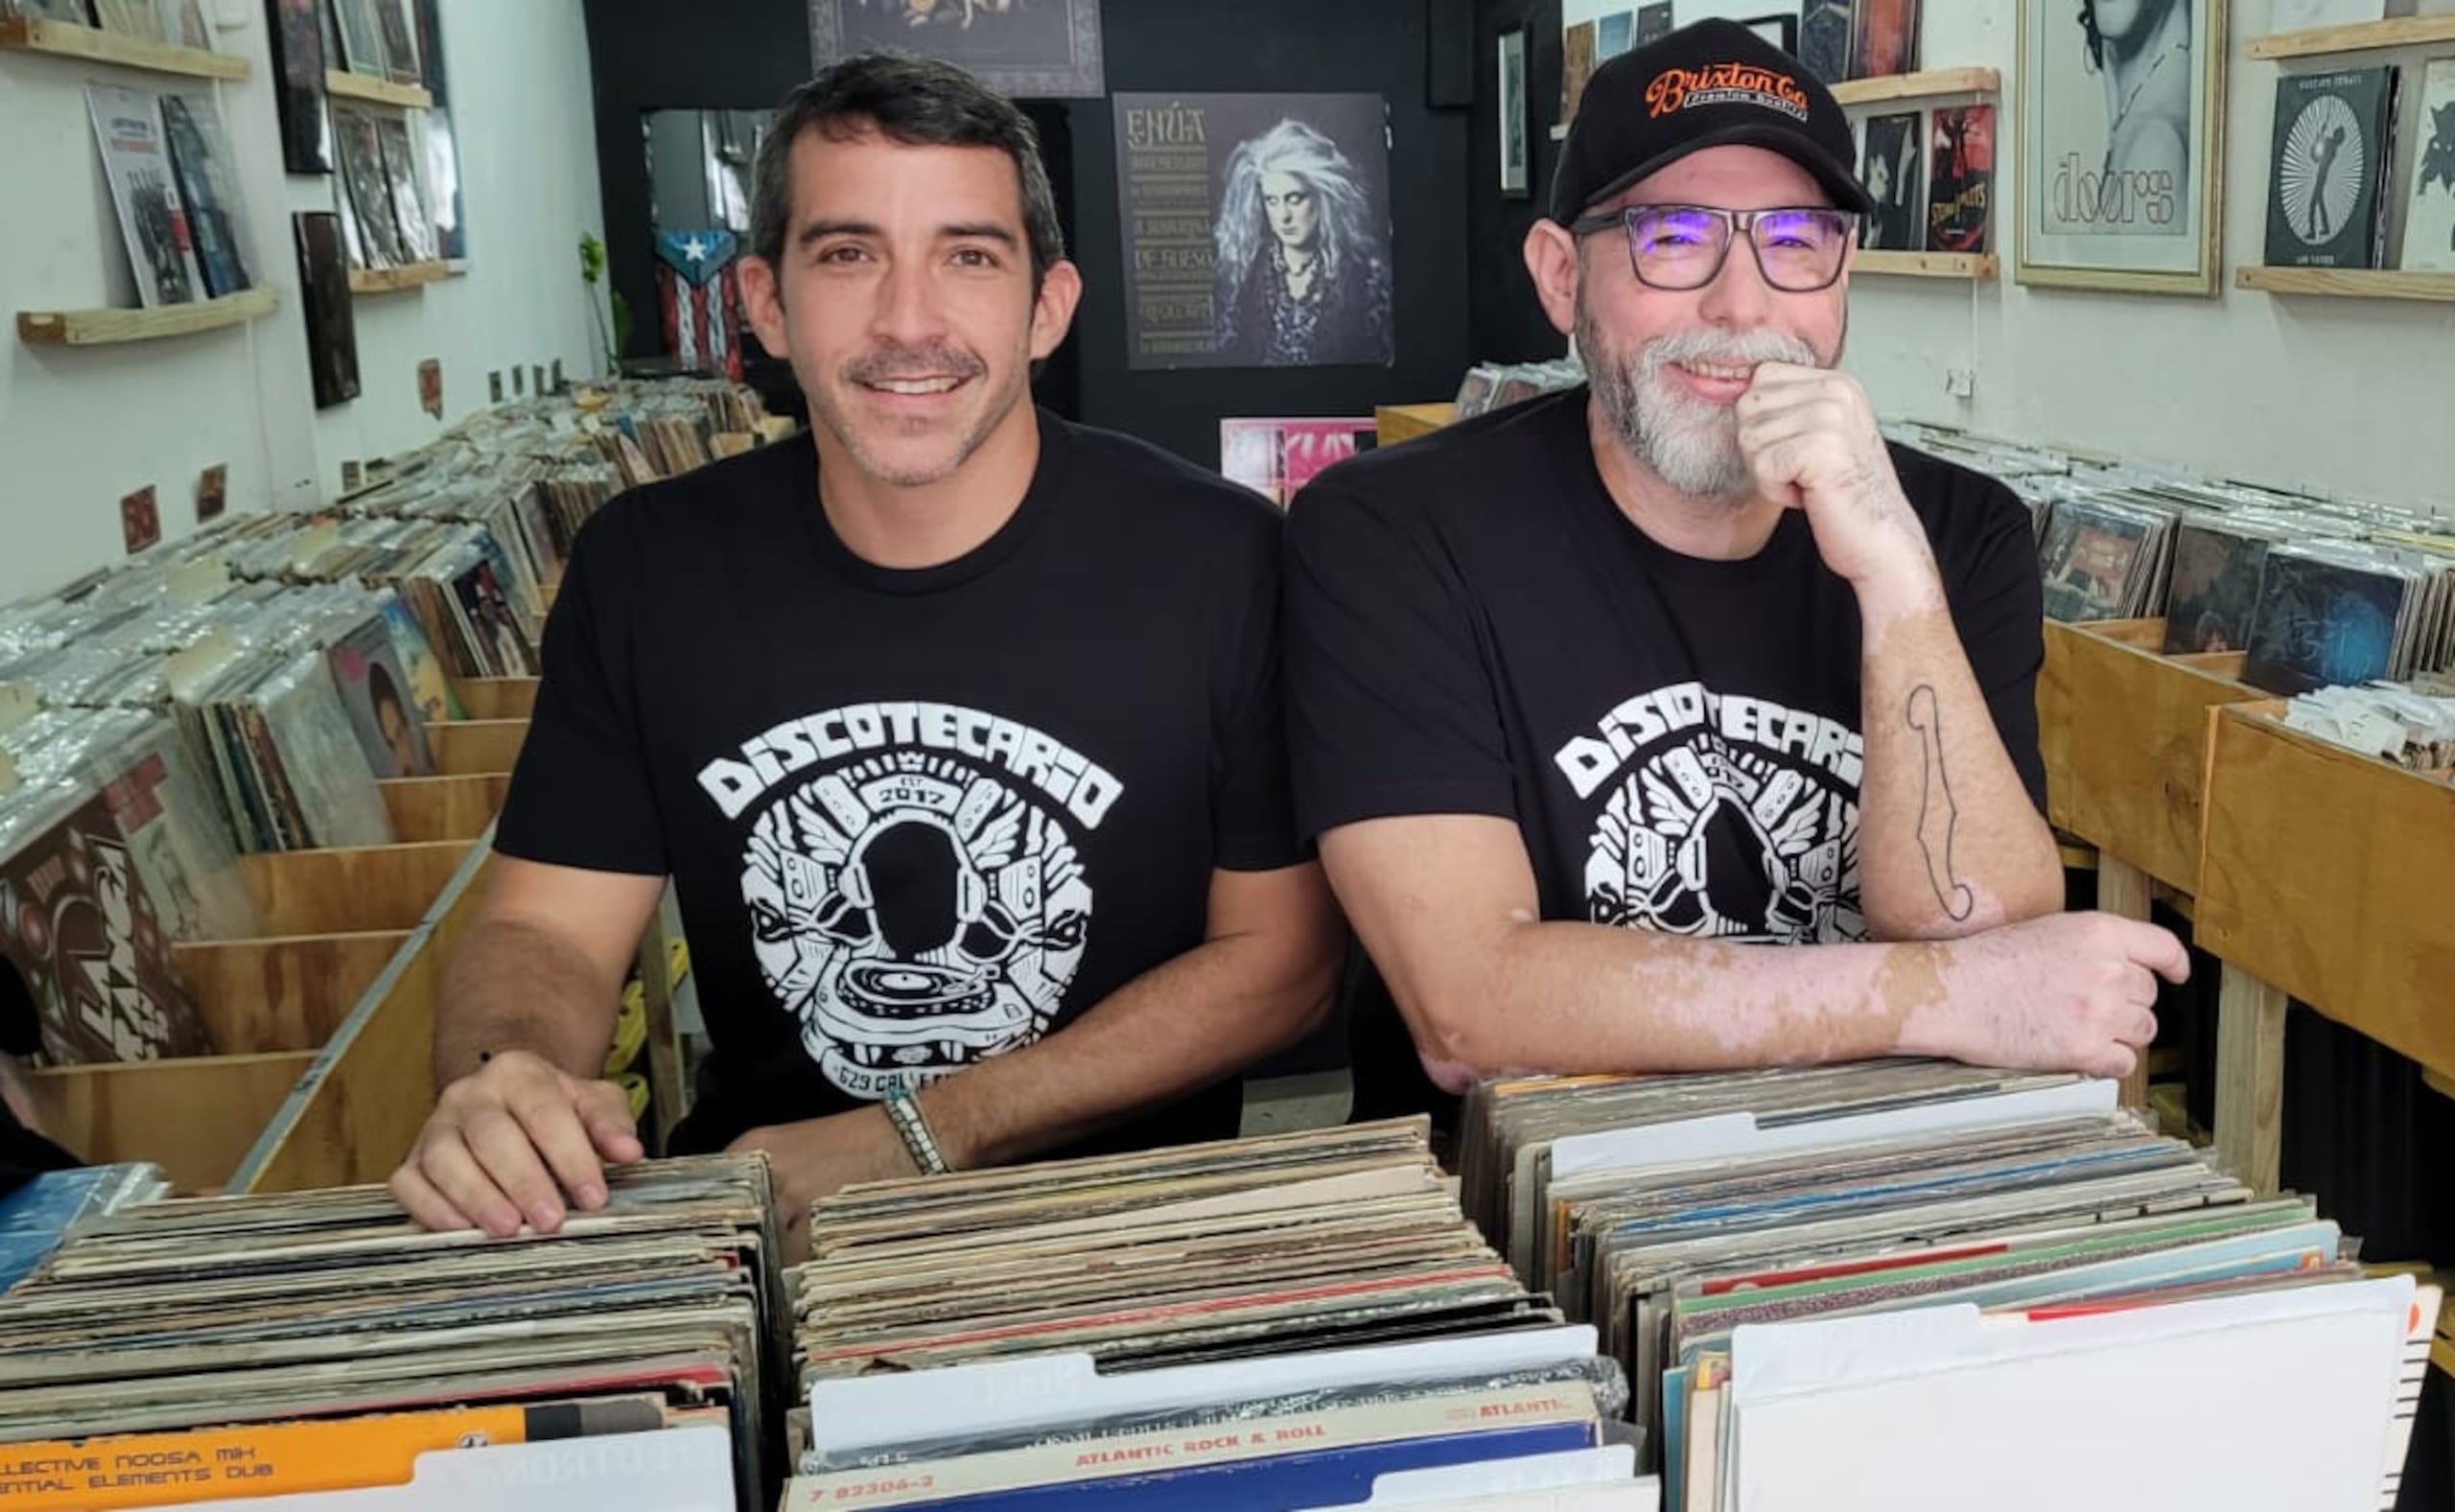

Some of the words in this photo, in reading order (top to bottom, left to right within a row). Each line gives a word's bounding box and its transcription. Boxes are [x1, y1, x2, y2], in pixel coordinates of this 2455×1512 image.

[1646, 61, 1772, 118] Brixton
[878, 787, 946, 804] 2017
[839, 1066, 871, 1090] 629
[1076, 1442, 1174, 1467] ATLANTIC
[1183, 1434, 1239, 1453] ROCK
[1276, 1424, 1326, 1441] ROLL
[810, 1489, 824, 1502] 7
